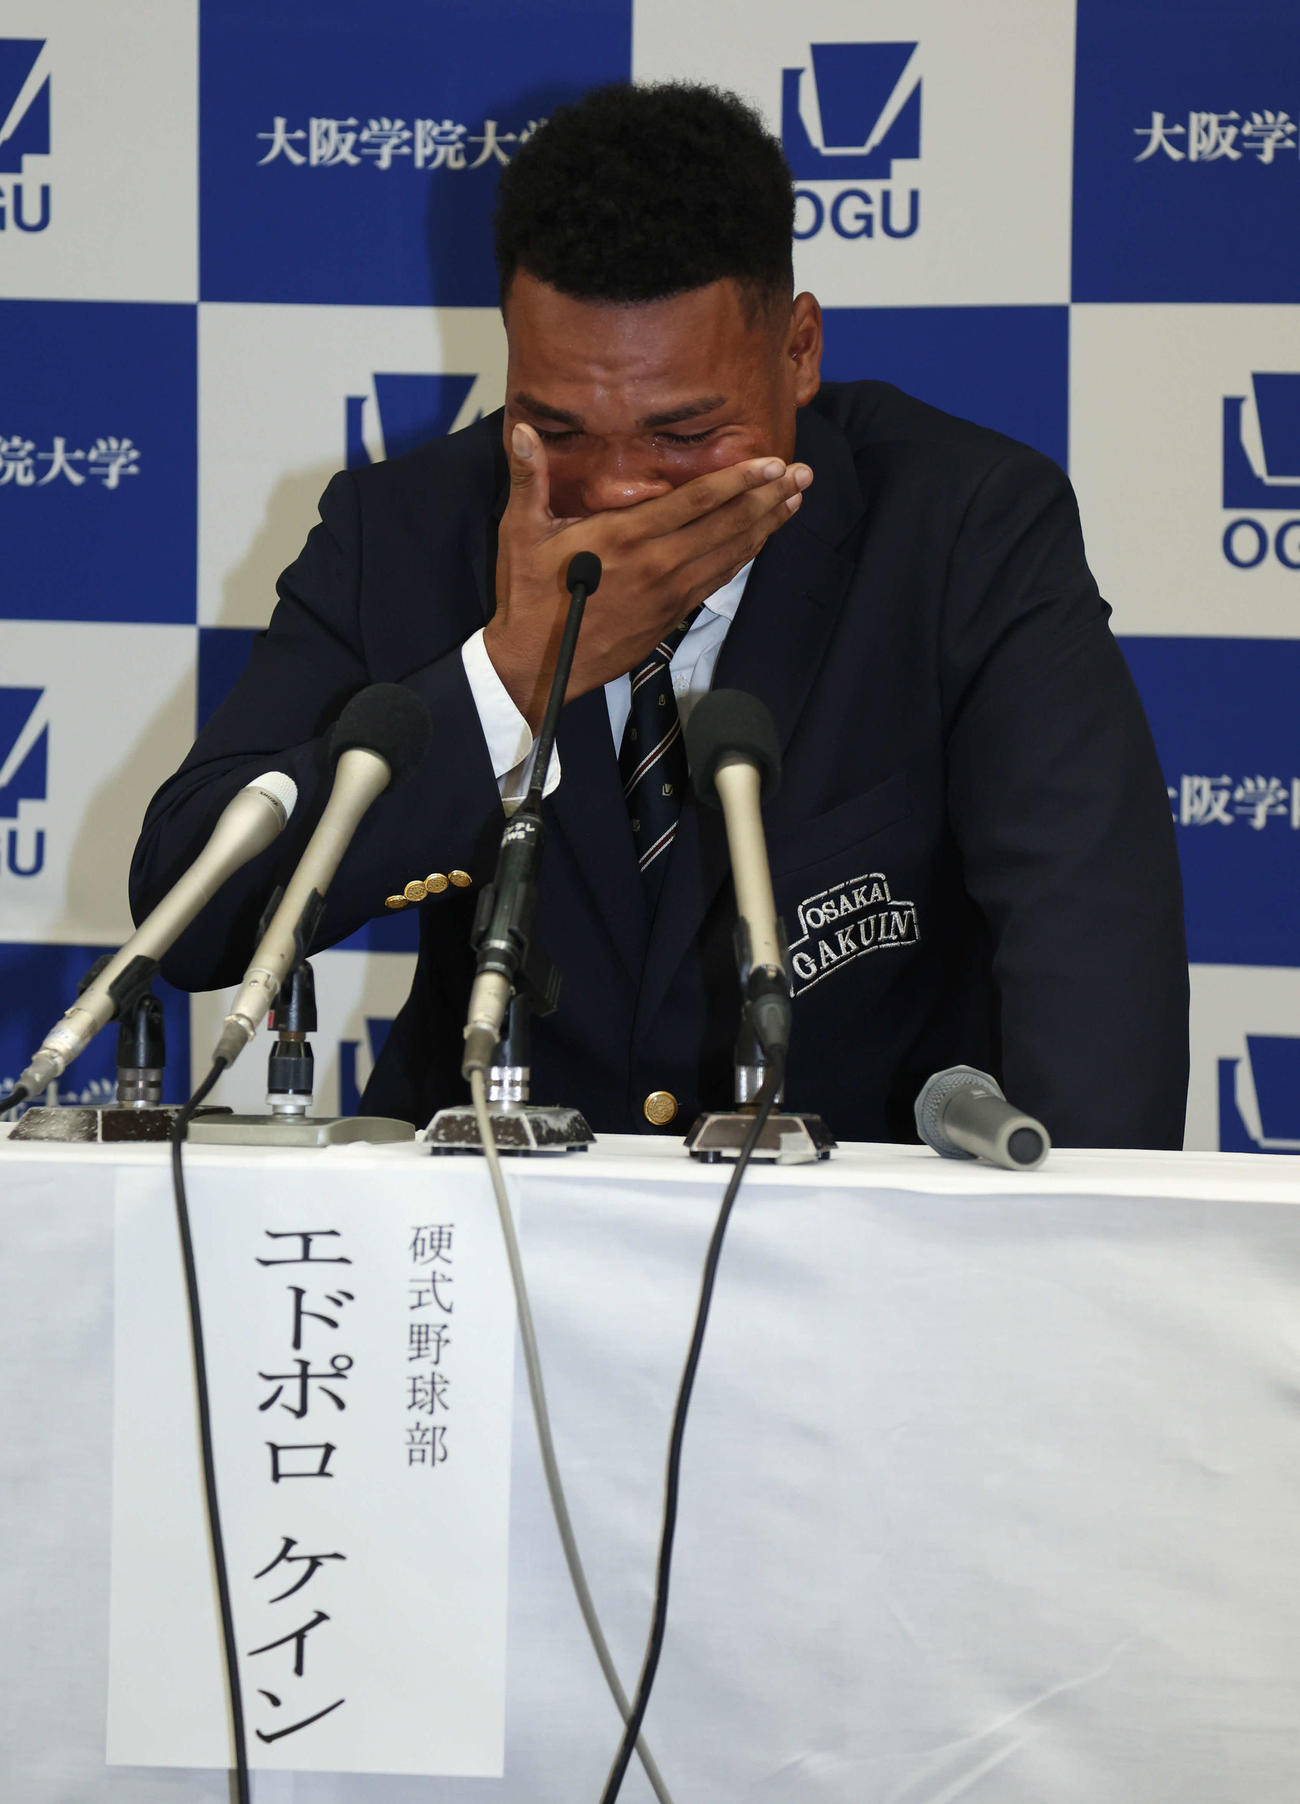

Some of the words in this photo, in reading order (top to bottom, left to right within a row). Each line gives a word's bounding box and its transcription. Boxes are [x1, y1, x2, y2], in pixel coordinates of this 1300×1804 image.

[257, 116, 549, 170] 大阪学院大
[792, 188, 920, 241] OGU
[805, 882, 886, 929] OSAKA
[792, 910, 914, 980] GAKUIN
[255, 1229, 355, 1484] エドポロ
[404, 1223, 455, 1468] 硬式野球部
[247, 1536, 347, 1744] ケイン
